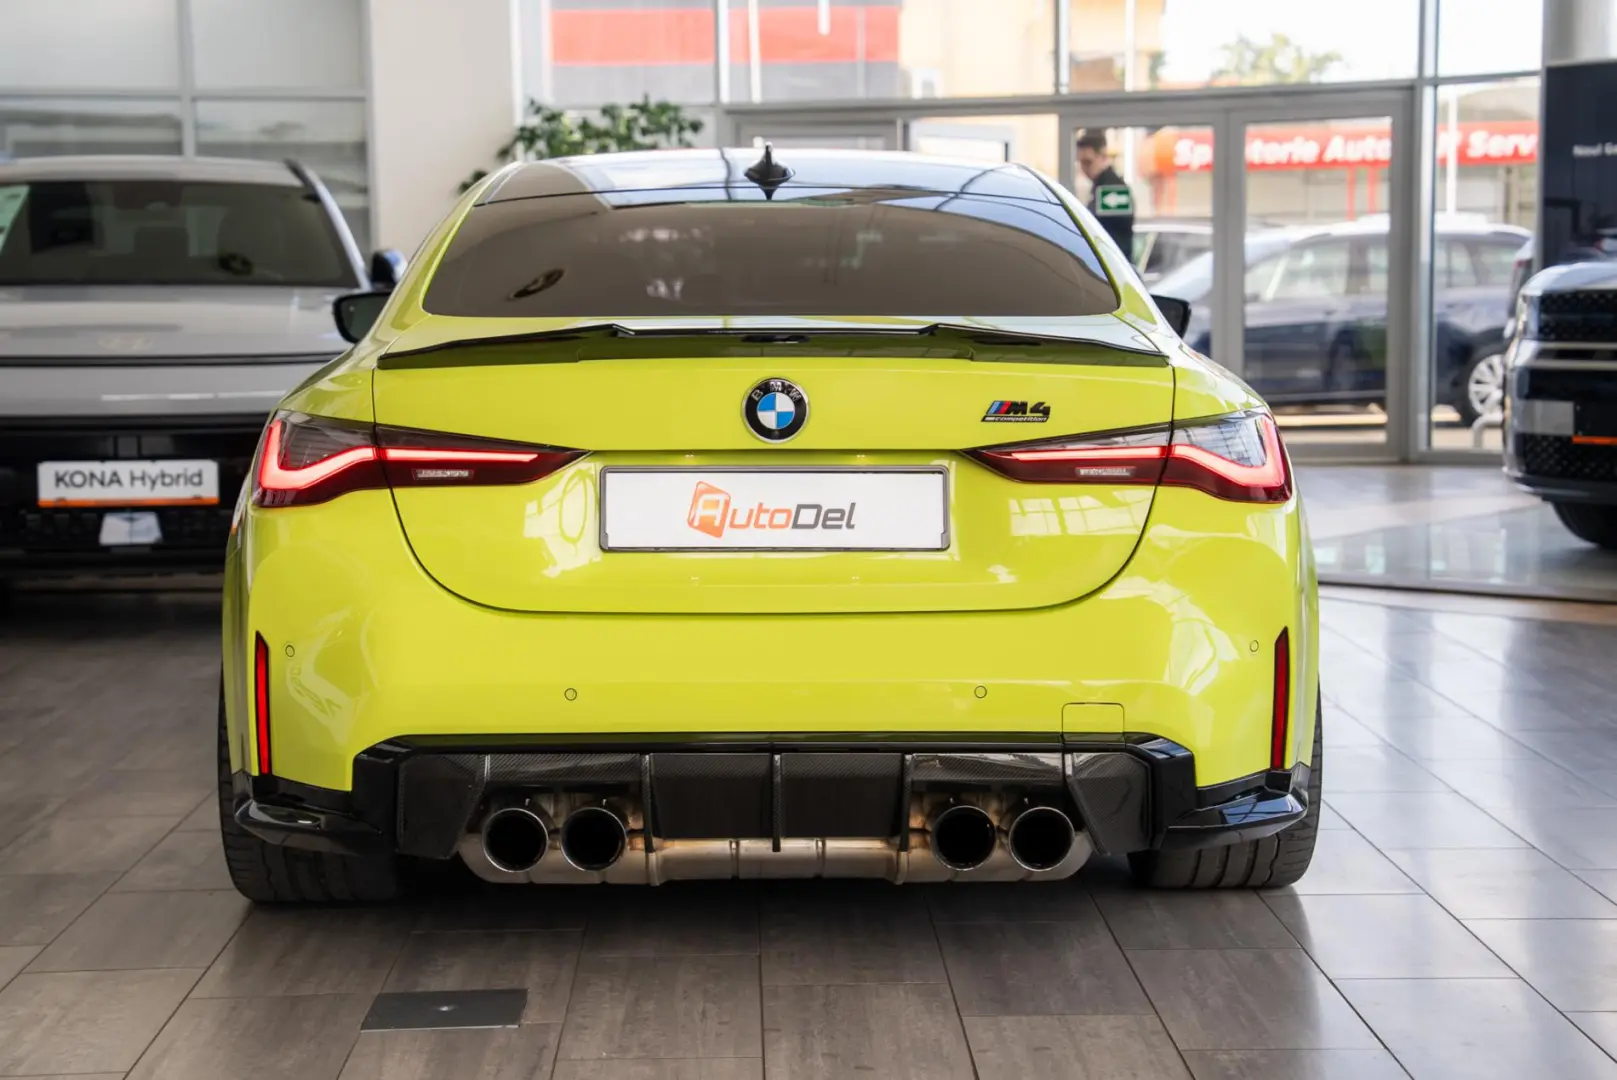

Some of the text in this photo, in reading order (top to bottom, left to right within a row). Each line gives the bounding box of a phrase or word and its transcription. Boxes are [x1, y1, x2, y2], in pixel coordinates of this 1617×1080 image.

[751, 381, 802, 402] BMW
[1002, 400, 1051, 417] M4
[54, 468, 204, 492] KONA Hybrid
[690, 490, 857, 532] AutoDel
